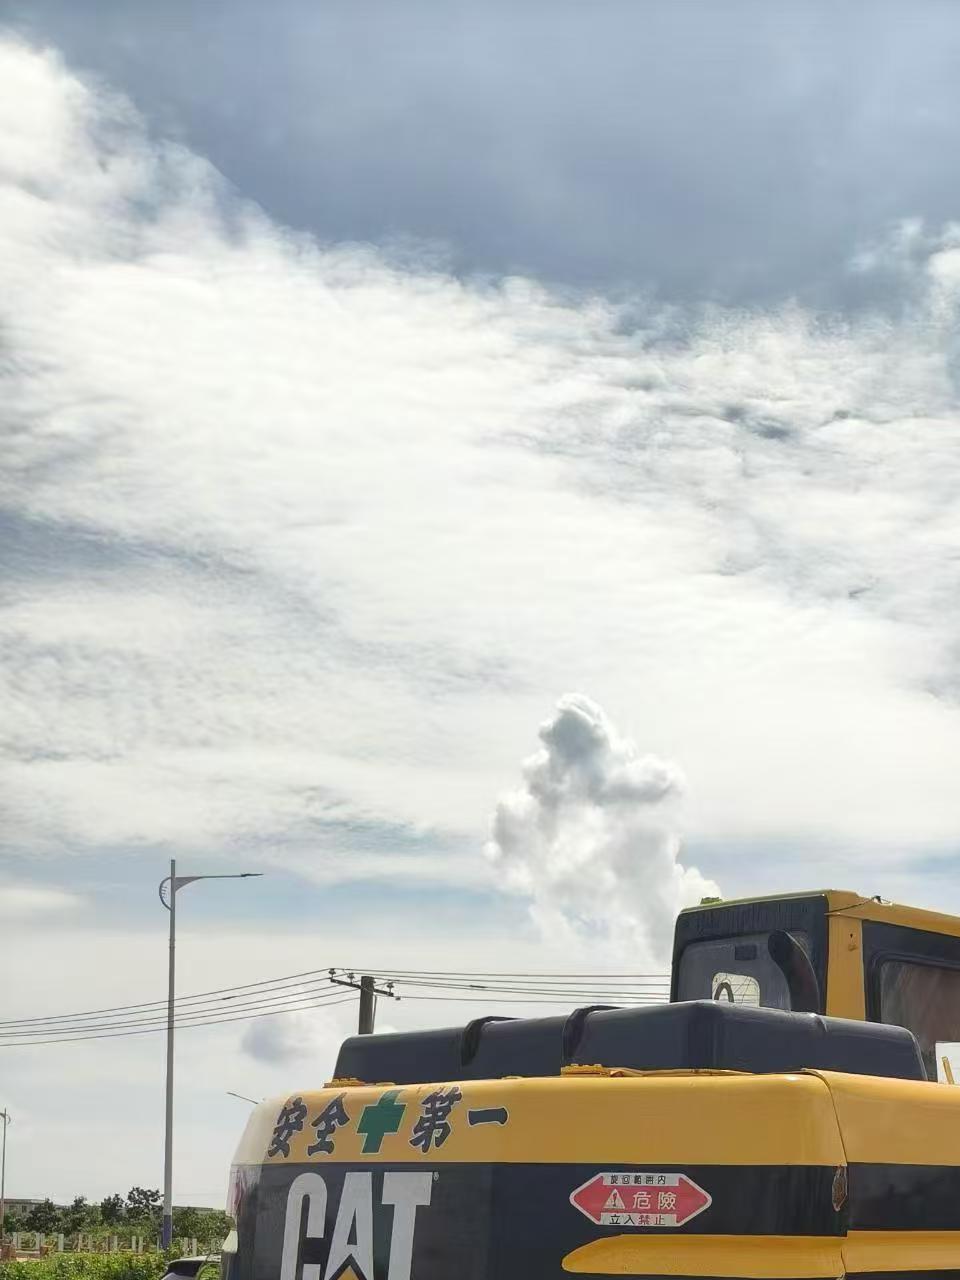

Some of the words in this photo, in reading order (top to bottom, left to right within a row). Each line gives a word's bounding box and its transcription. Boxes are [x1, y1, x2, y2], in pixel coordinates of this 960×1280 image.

[268, 1092, 350, 1157] 安全
[409, 1086, 508, 1153] 第一
[632, 1191, 677, 1210] 危險
[609, 1214, 666, 1225] 立入禁止
